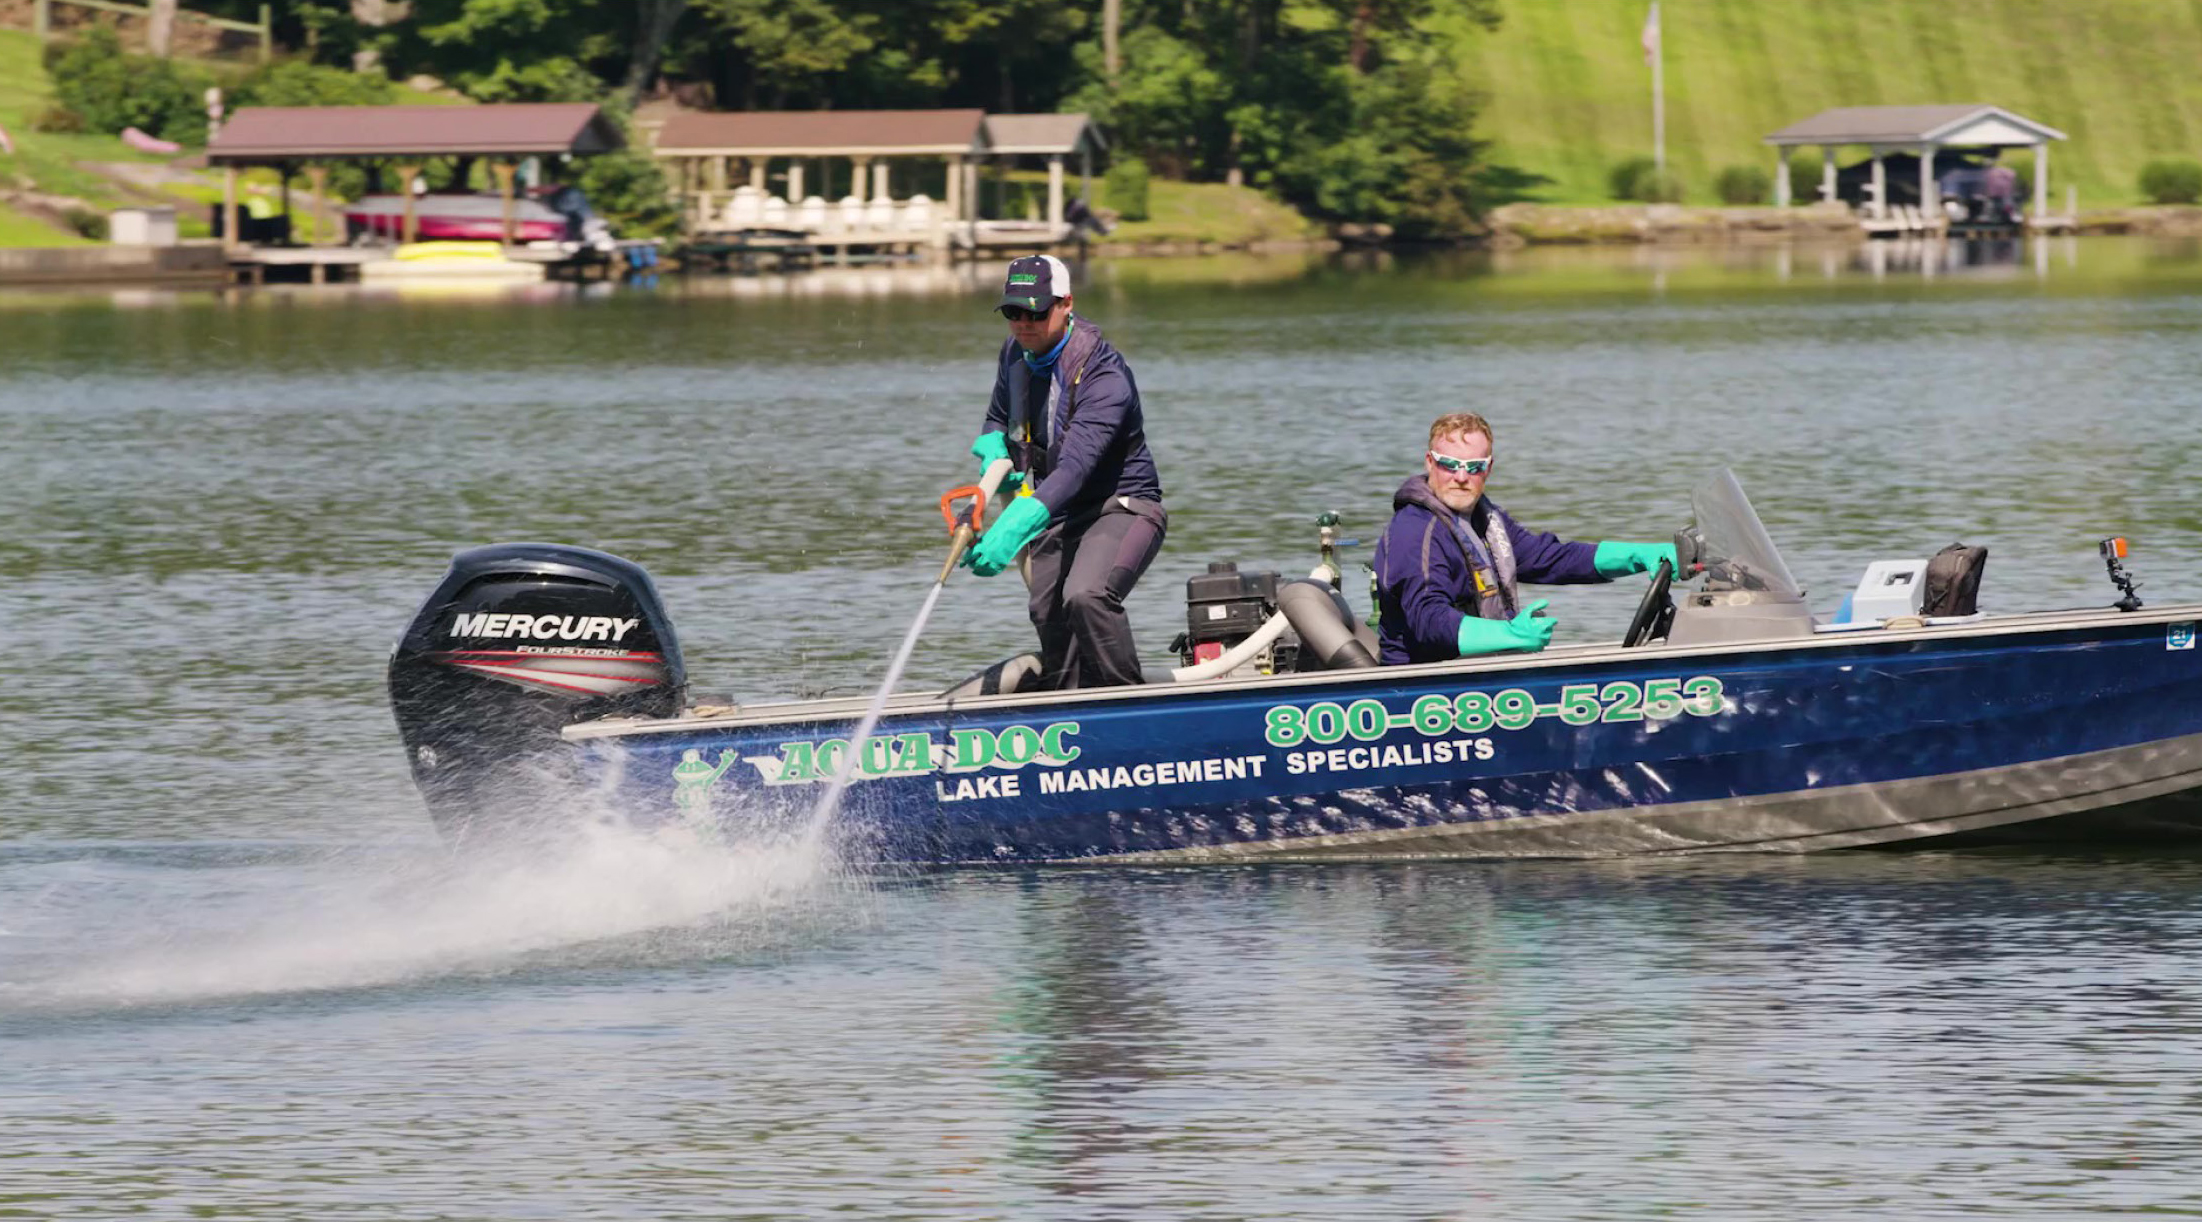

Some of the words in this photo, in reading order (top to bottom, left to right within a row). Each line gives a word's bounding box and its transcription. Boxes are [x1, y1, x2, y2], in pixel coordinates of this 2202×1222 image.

[450, 613, 640, 642] MERCURY
[2173, 630, 2186, 639] 21
[516, 645, 630, 656] FOURSTROKE
[1265, 676, 1724, 747] 800-689-5253
[948, 721, 1081, 769] DOC
[936, 774, 1020, 801] LAKE
[1039, 755, 1266, 795] MANAGEMENT
[1286, 738, 1494, 775] SPECIALISTS
